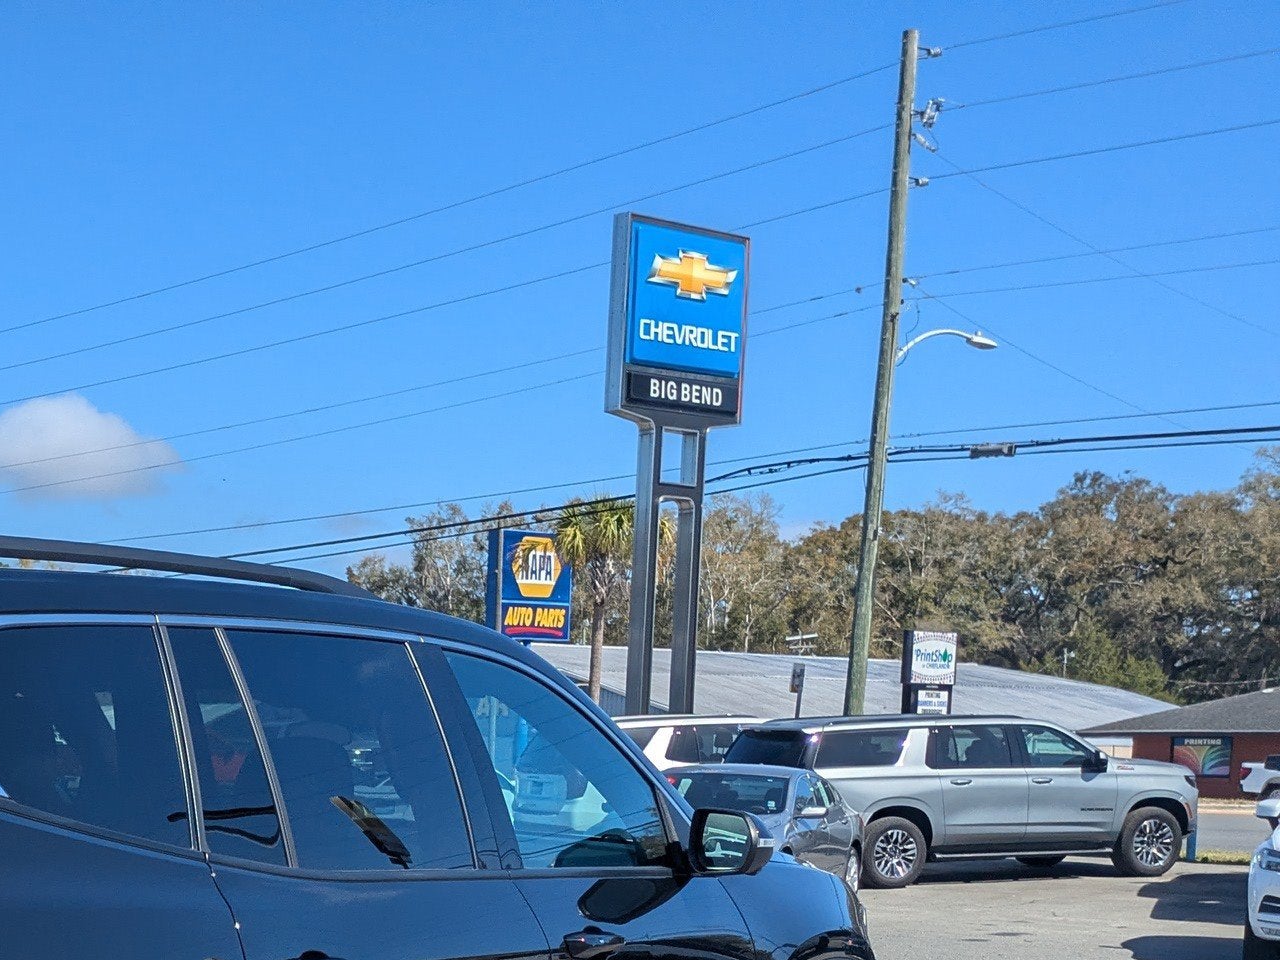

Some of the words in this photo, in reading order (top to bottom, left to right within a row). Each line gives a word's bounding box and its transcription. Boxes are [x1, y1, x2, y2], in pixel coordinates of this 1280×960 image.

[640, 318, 739, 352] CHEVROLET
[649, 378, 677, 400] BIG
[681, 382, 722, 406] BEND
[504, 606, 533, 626] AUTO
[535, 608, 565, 628] PARTS
